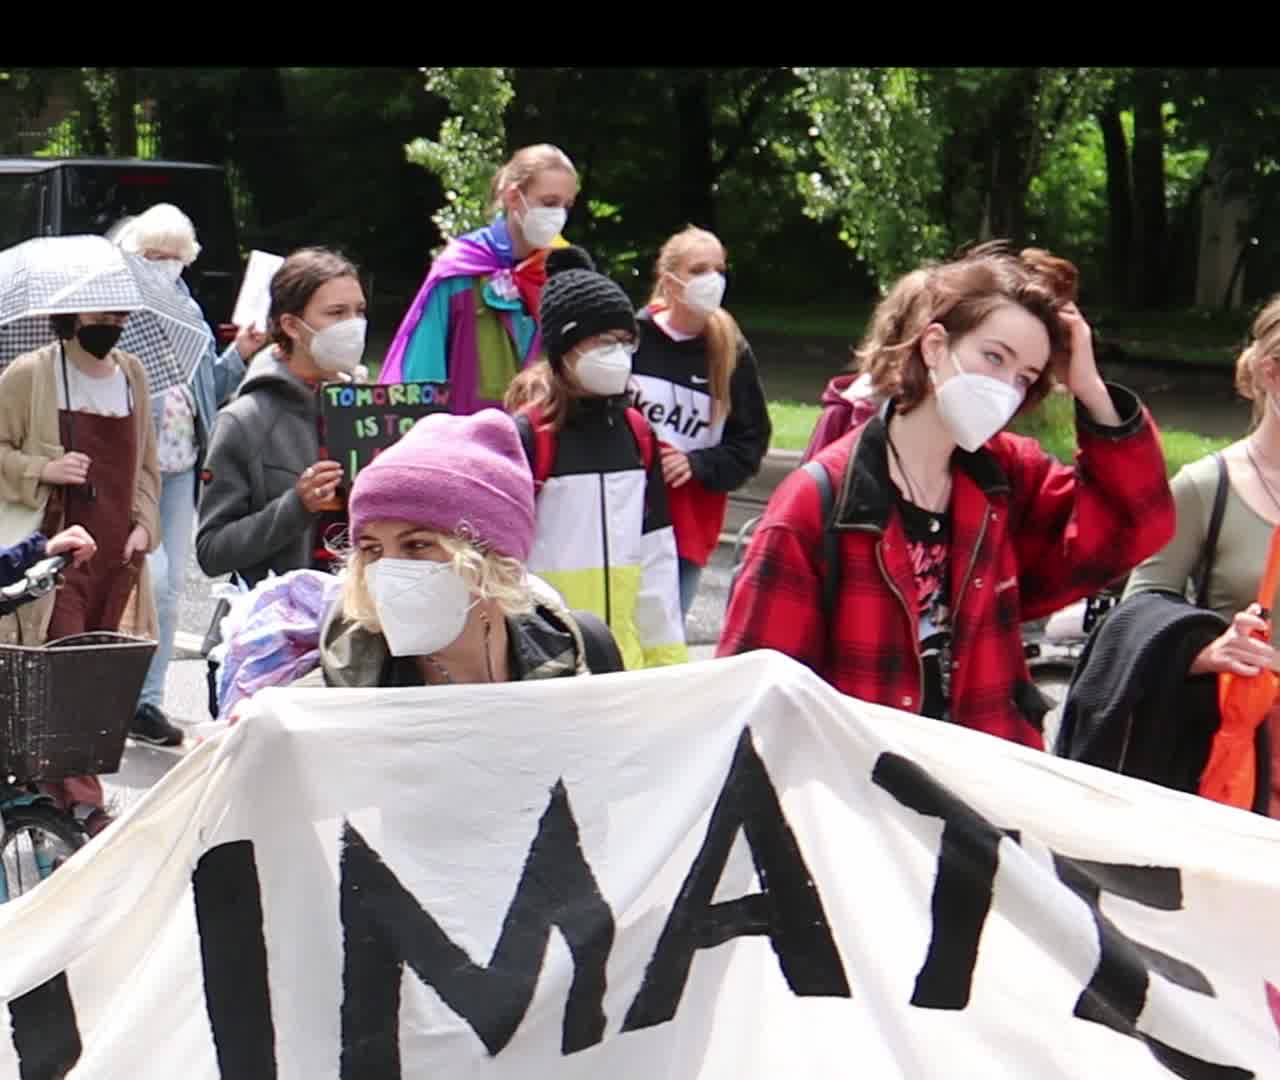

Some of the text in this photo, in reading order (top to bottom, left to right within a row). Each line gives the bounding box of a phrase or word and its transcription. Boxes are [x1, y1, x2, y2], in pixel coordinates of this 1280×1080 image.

[325, 384, 449, 407] TOMORROW
[355, 414, 417, 438] IS TO
[627, 389, 711, 439] keAir
